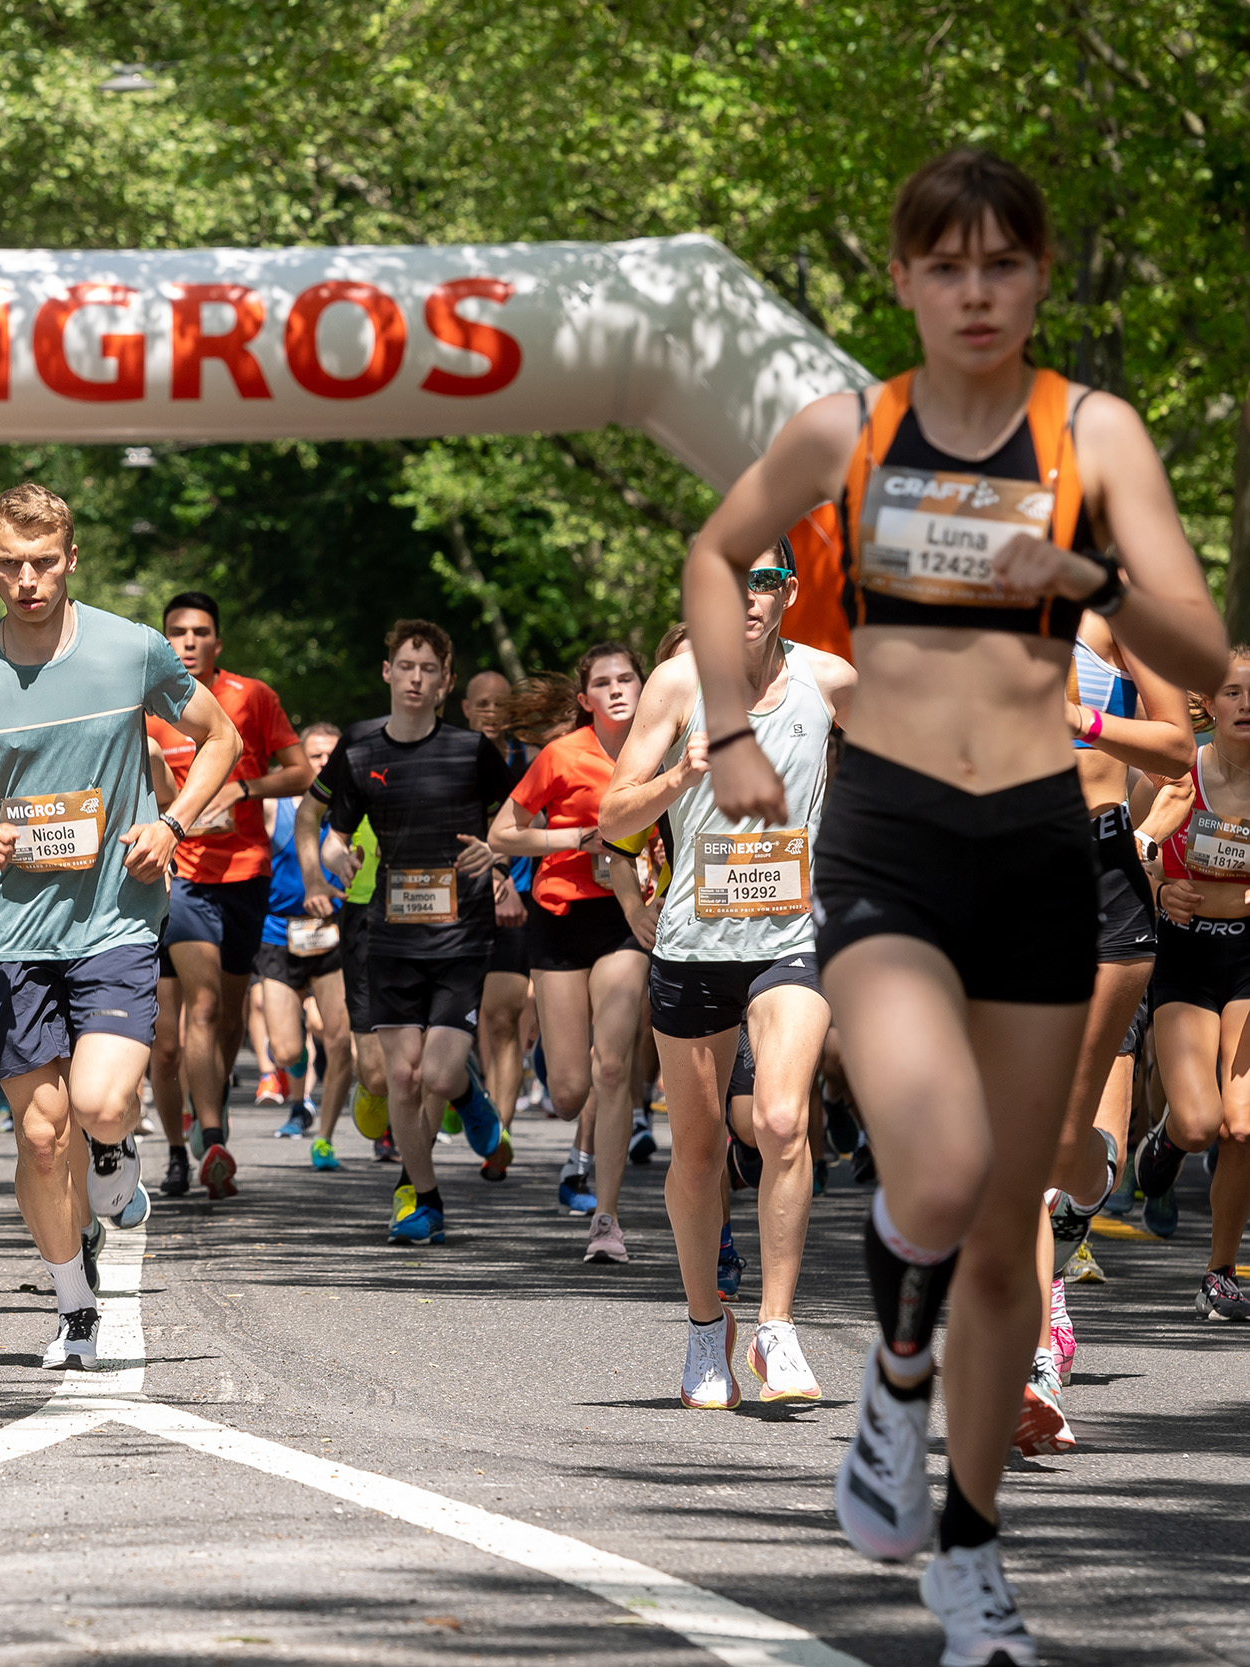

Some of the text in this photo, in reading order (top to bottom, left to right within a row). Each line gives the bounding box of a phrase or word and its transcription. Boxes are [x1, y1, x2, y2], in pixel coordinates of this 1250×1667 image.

[884, 476, 978, 502] CRAFT
[927, 519, 989, 551] Luna
[920, 552, 992, 579] 12425
[6, 801, 66, 820] MIGROS
[32, 826, 75, 842] Nicola
[1198, 817, 1250, 836] BERNEXPO
[36, 842, 76, 857] 16399
[704, 840, 773, 855] BERNEXPO
[1217, 841, 1246, 859] Lena
[1213, 856, 1246, 869] 18172
[727, 868, 781, 884] Andrea
[403, 892, 436, 902] Ramon
[733, 885, 777, 900] 19292
[406, 903, 434, 912] 19944
[1195, 921, 1246, 936] PRO
